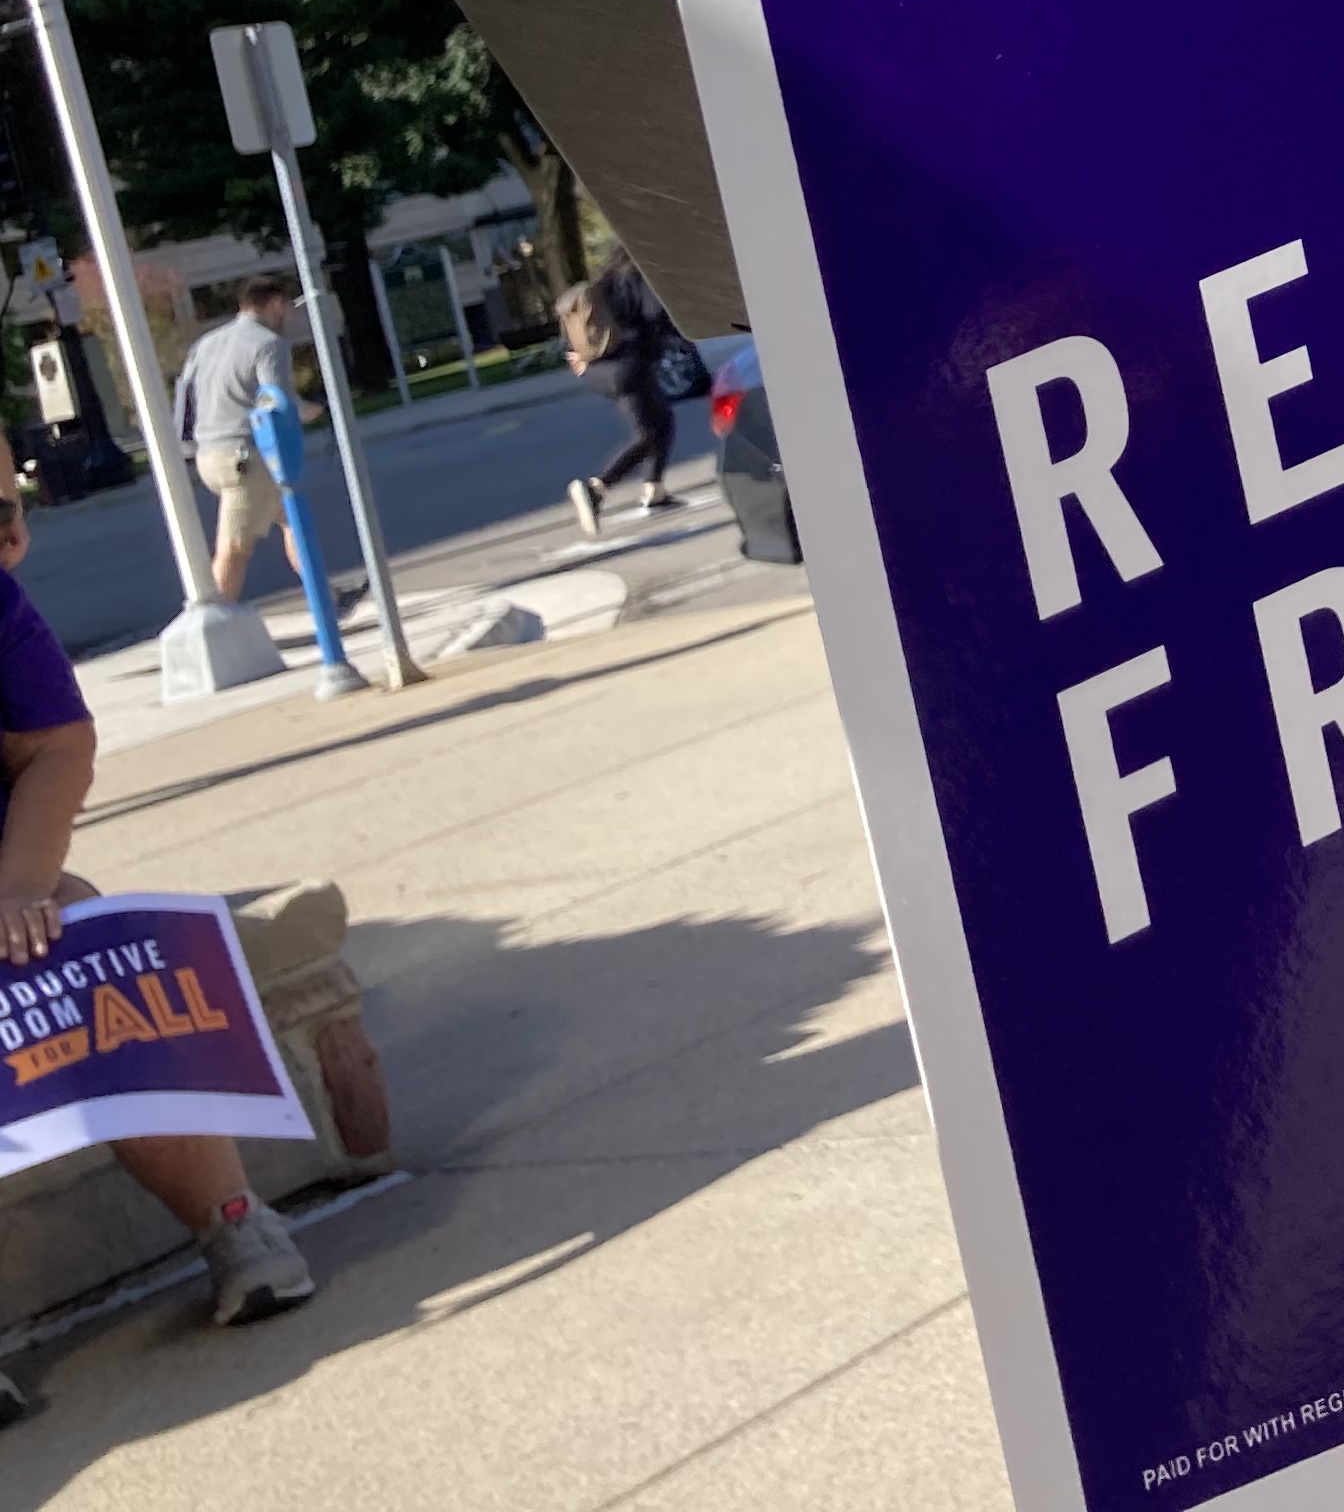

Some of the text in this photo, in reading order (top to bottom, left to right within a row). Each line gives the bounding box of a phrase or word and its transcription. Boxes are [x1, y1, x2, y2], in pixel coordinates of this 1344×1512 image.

[29, 966, 230, 1070] FOR ALL
[1142, 1455, 1191, 1491] PAID
[1196, 1434, 1241, 1468] FOR
[1242, 1411, 1297, 1448] WITH
